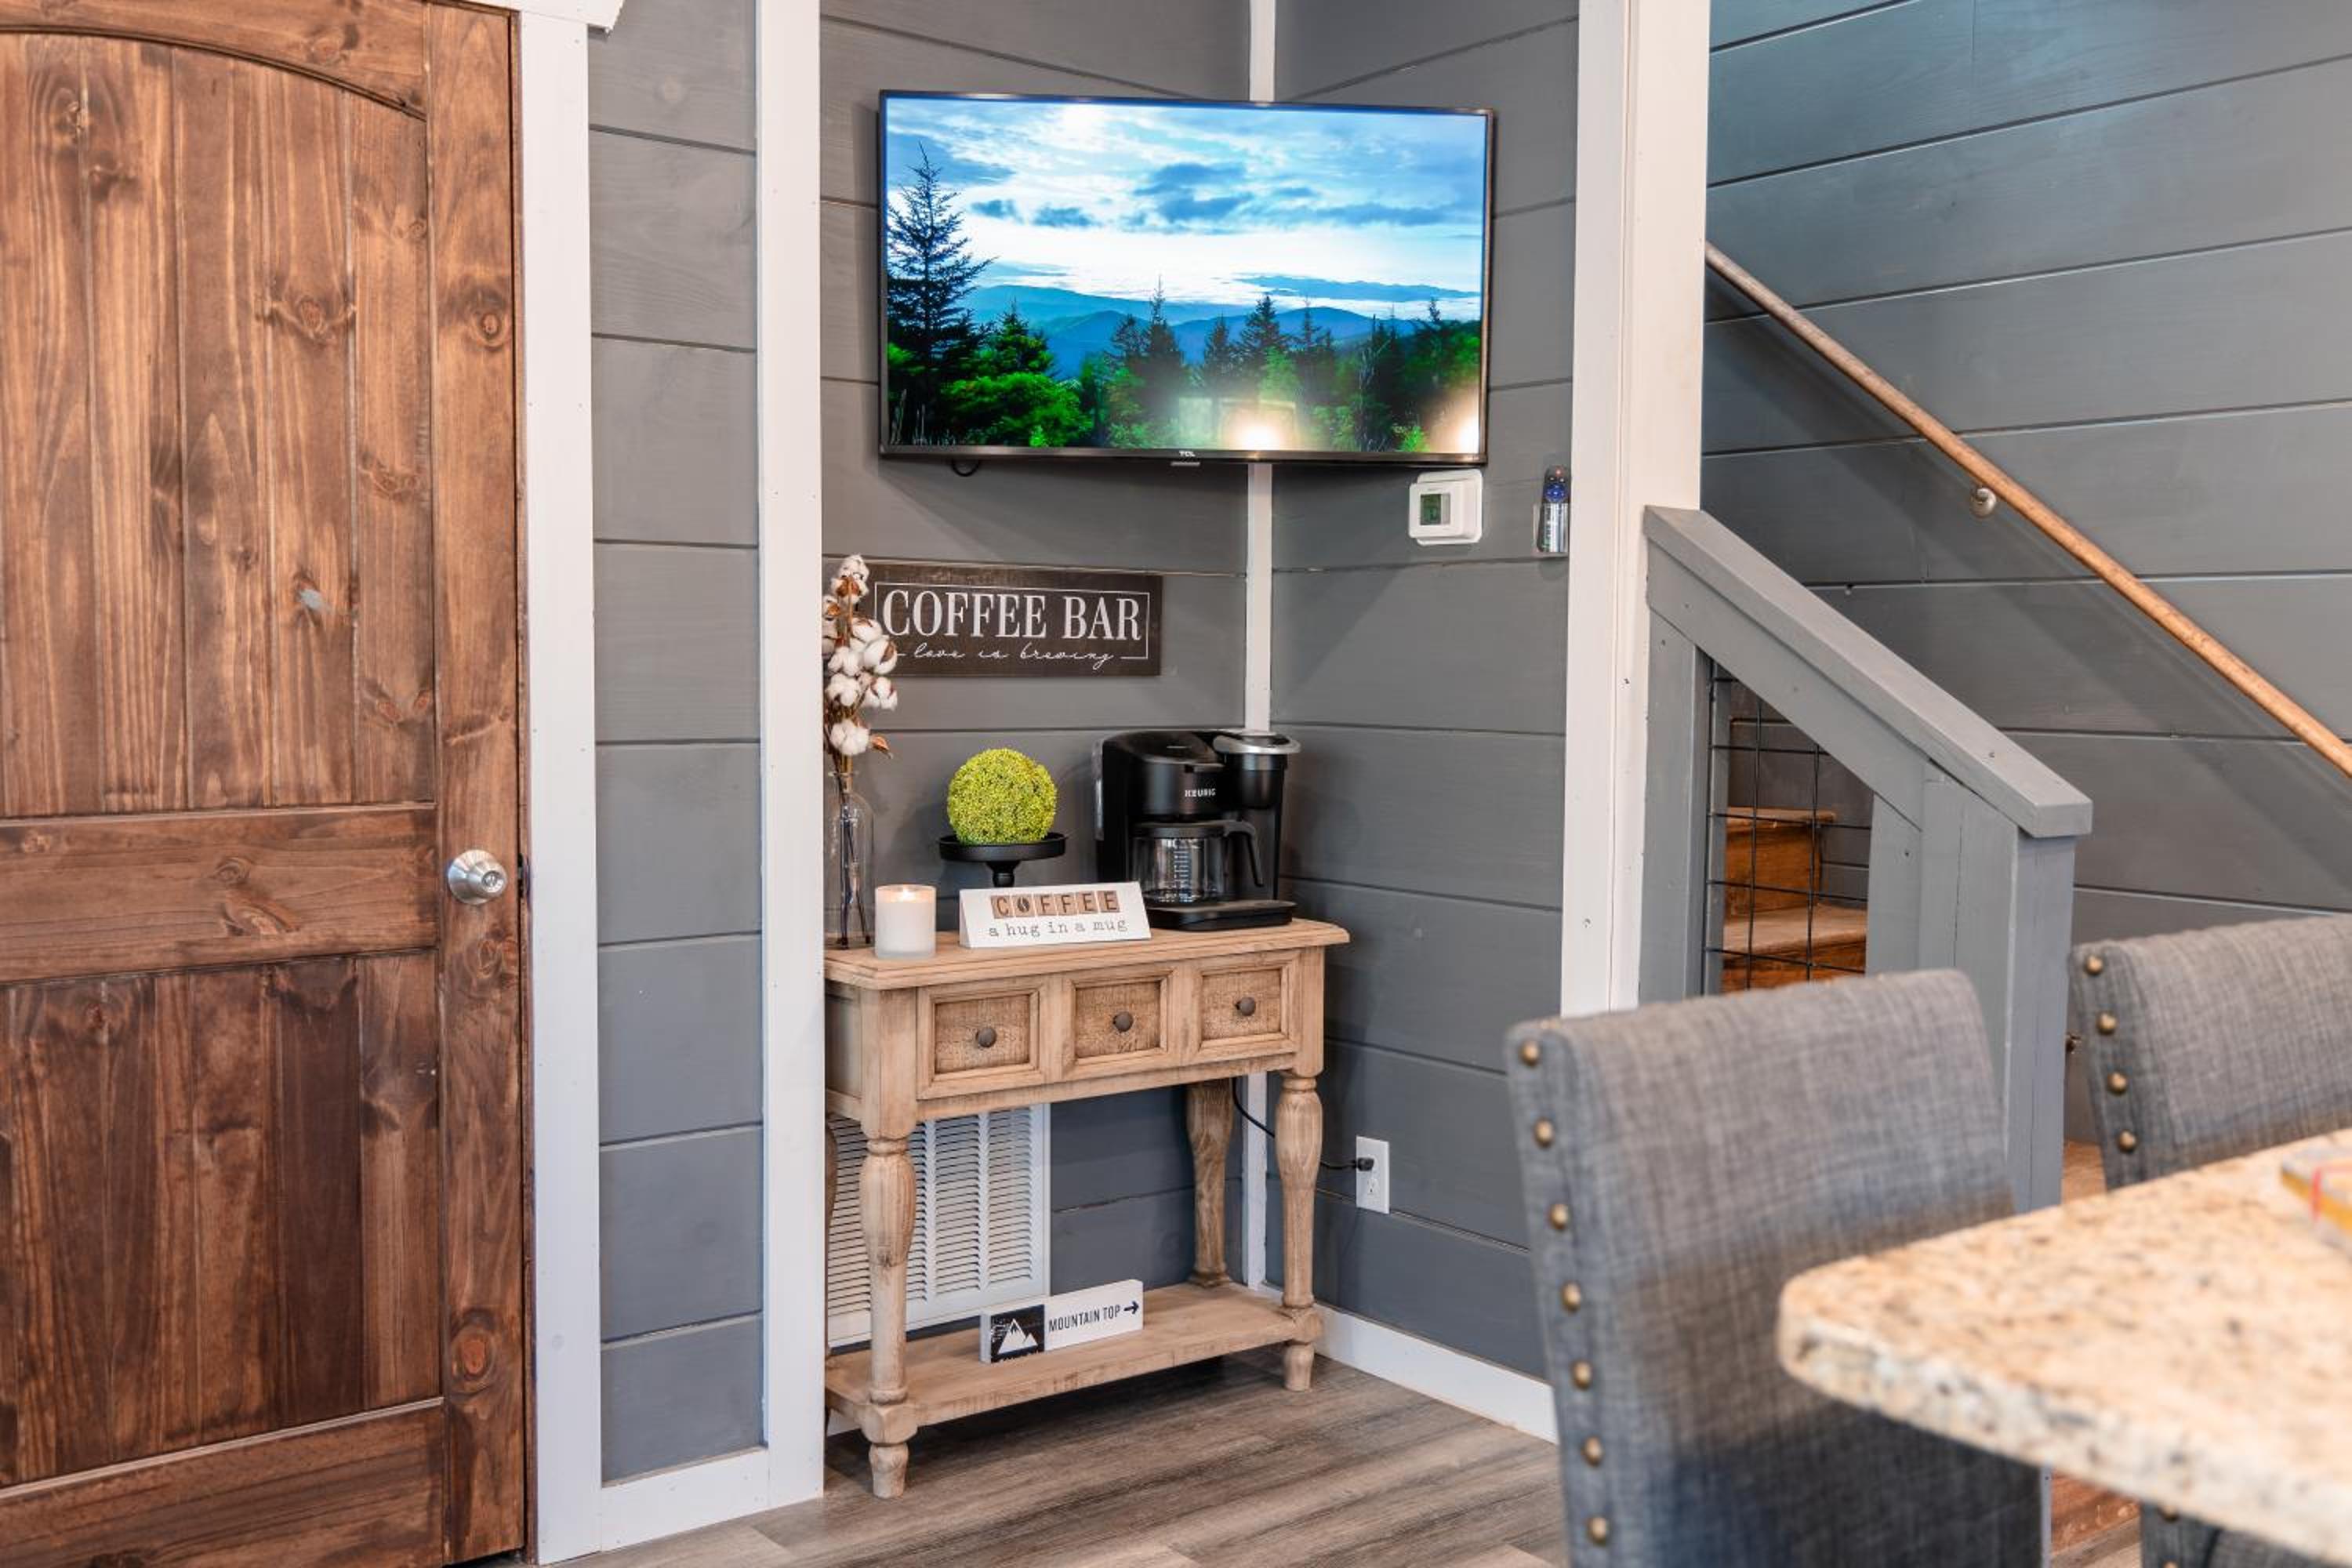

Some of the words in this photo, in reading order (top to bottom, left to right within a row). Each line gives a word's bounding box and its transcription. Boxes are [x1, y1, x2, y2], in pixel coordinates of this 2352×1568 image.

[882, 589, 1047, 639] COFFEE
[1062, 596, 1142, 641] BAR
[913, 641, 966, 659] love
[978, 648, 1010, 659] is
[1020, 641, 1114, 670] brewing
[1184, 788, 1216, 798] KEURIG
[995, 891, 1119, 916] COFFEE
[989, 926, 1000, 938] a
[1006, 923, 1041, 938] hug
[1047, 920, 1069, 935] in
[1074, 922, 1086, 932] a
[1093, 919, 1129, 933] mug
[1048, 1311, 1101, 1333] MOUNTAIN
[1102, 1305, 1121, 1320] TOP
